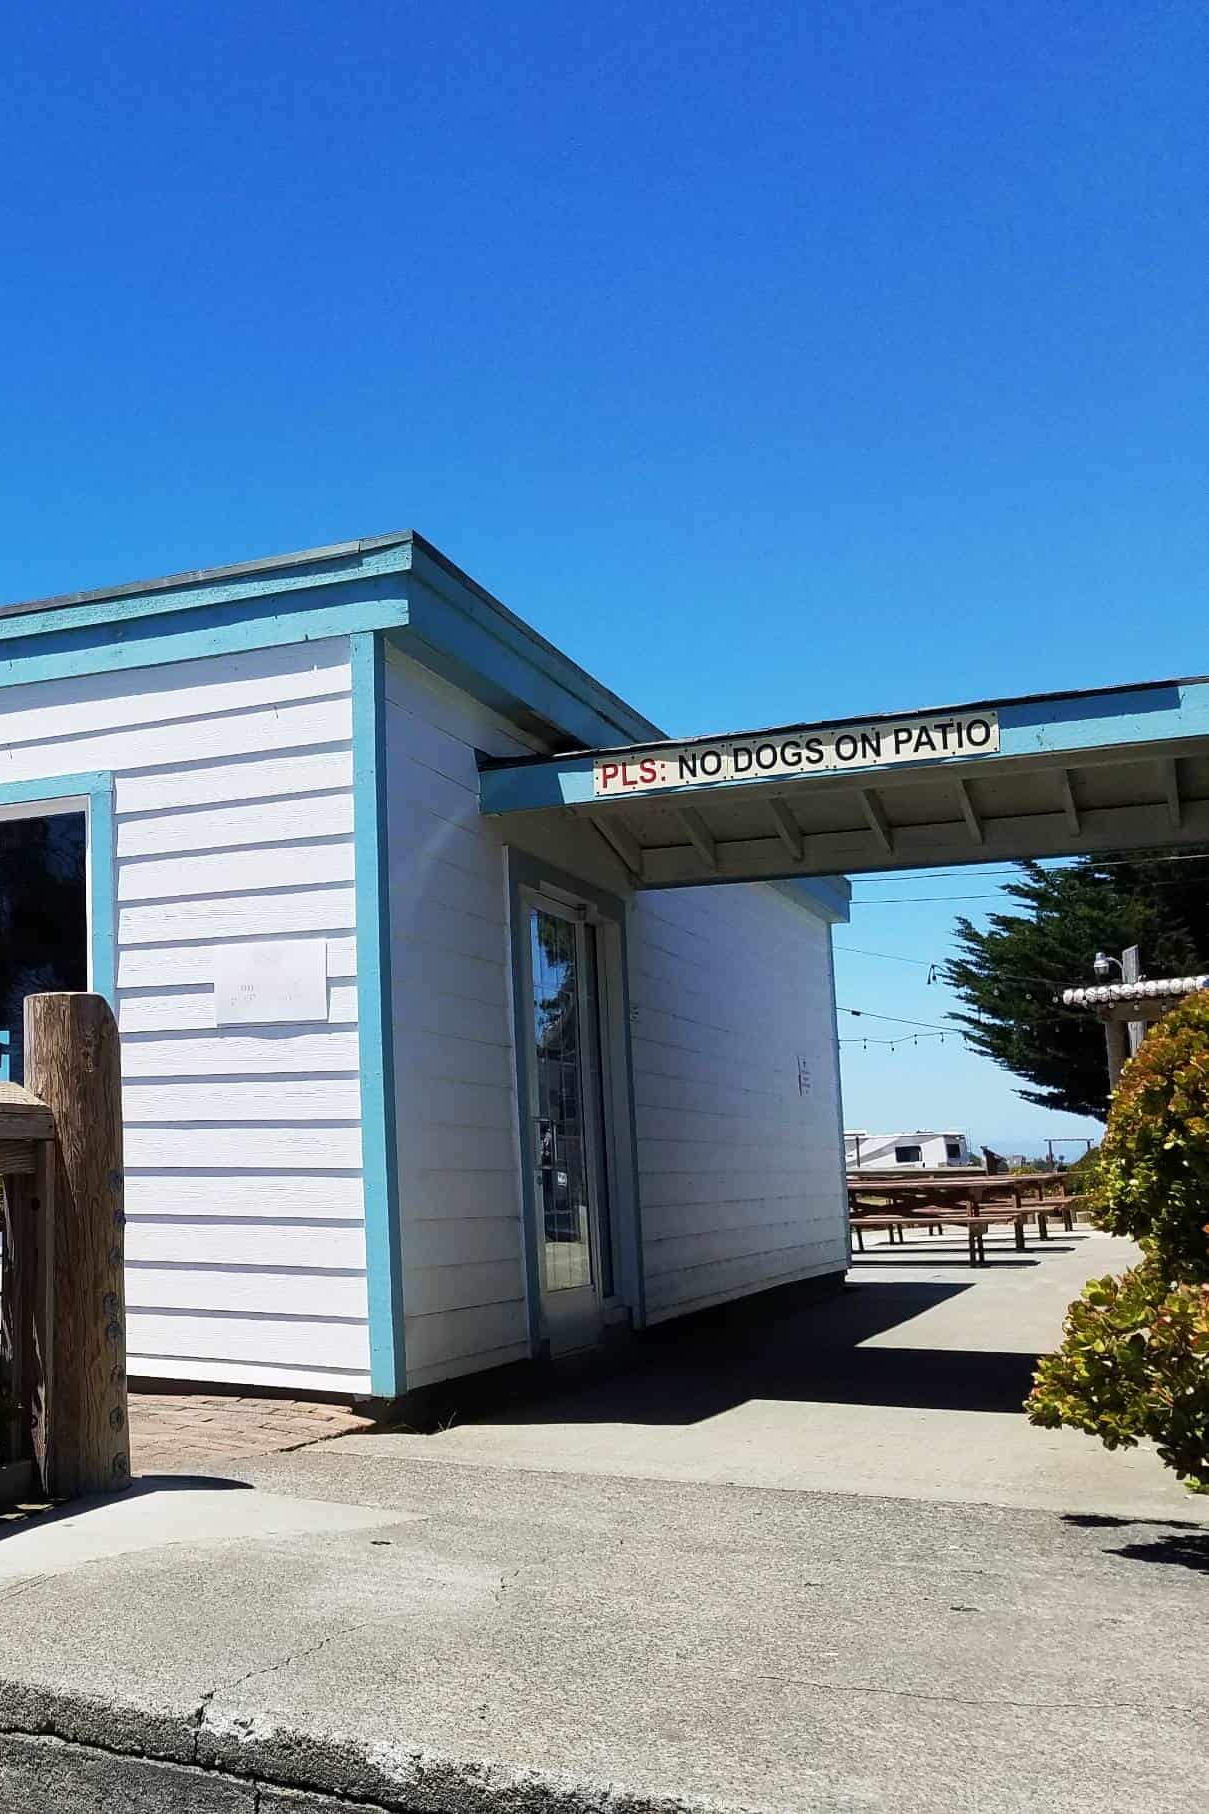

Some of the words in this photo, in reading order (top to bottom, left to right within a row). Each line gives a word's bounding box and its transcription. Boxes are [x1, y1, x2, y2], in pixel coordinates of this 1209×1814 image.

[601, 758, 666, 789] PLS:
[678, 750, 723, 781] NO
[733, 737, 825, 774] DOGS
[834, 729, 882, 762] ON
[893, 718, 991, 756] PATIO
